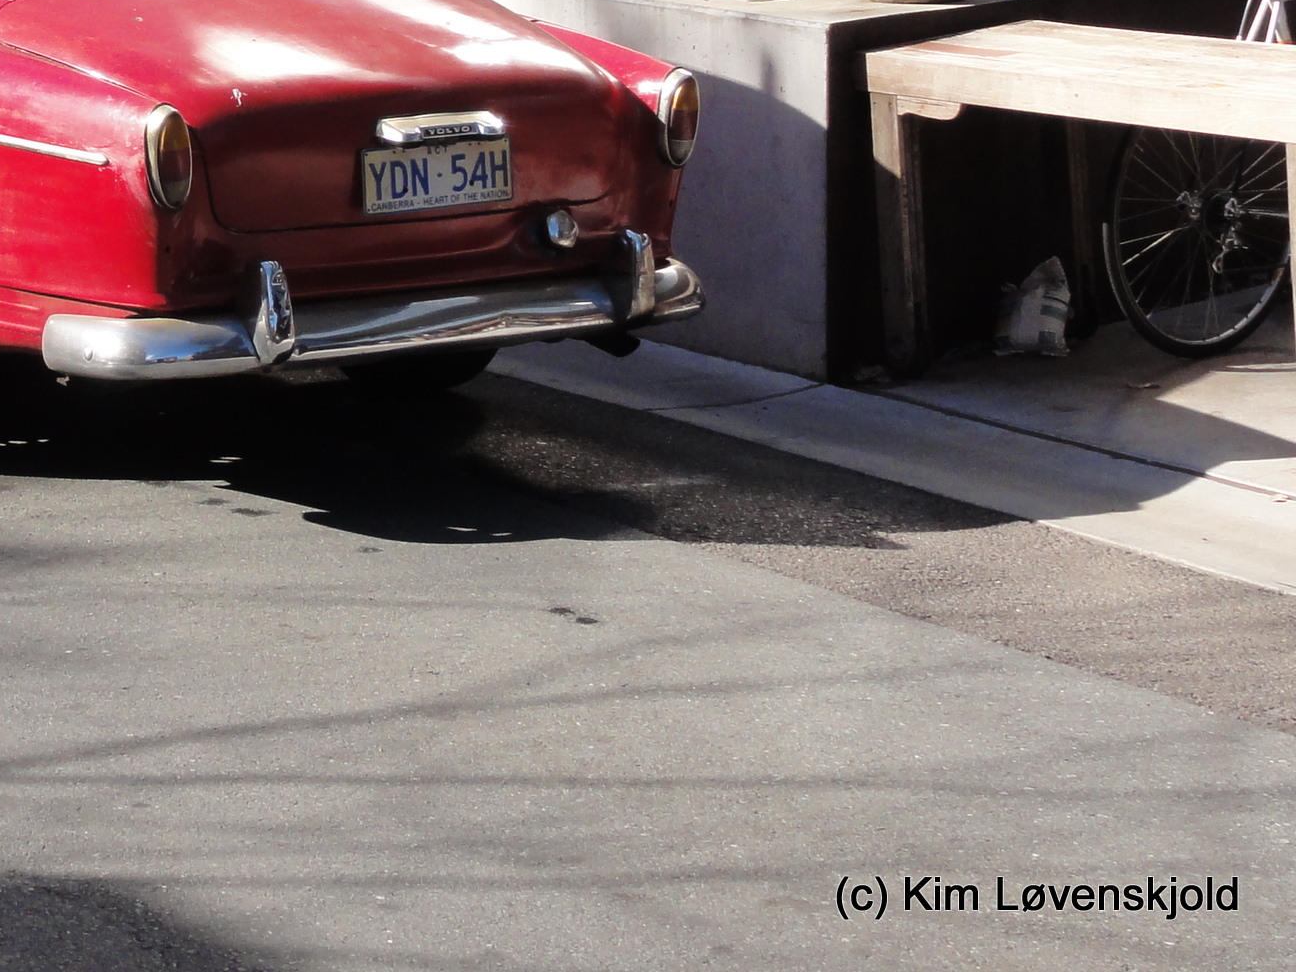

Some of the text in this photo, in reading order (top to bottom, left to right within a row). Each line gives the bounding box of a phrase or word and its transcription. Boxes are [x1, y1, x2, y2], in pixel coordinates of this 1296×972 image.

[428, 124, 471, 136] VOLVO
[368, 149, 510, 202] YDN 54H
[370, 200, 415, 212] CANBERRA
[423, 195, 449, 206] HEART
[450, 194, 461, 203] OF
[463, 192, 478, 201] THE
